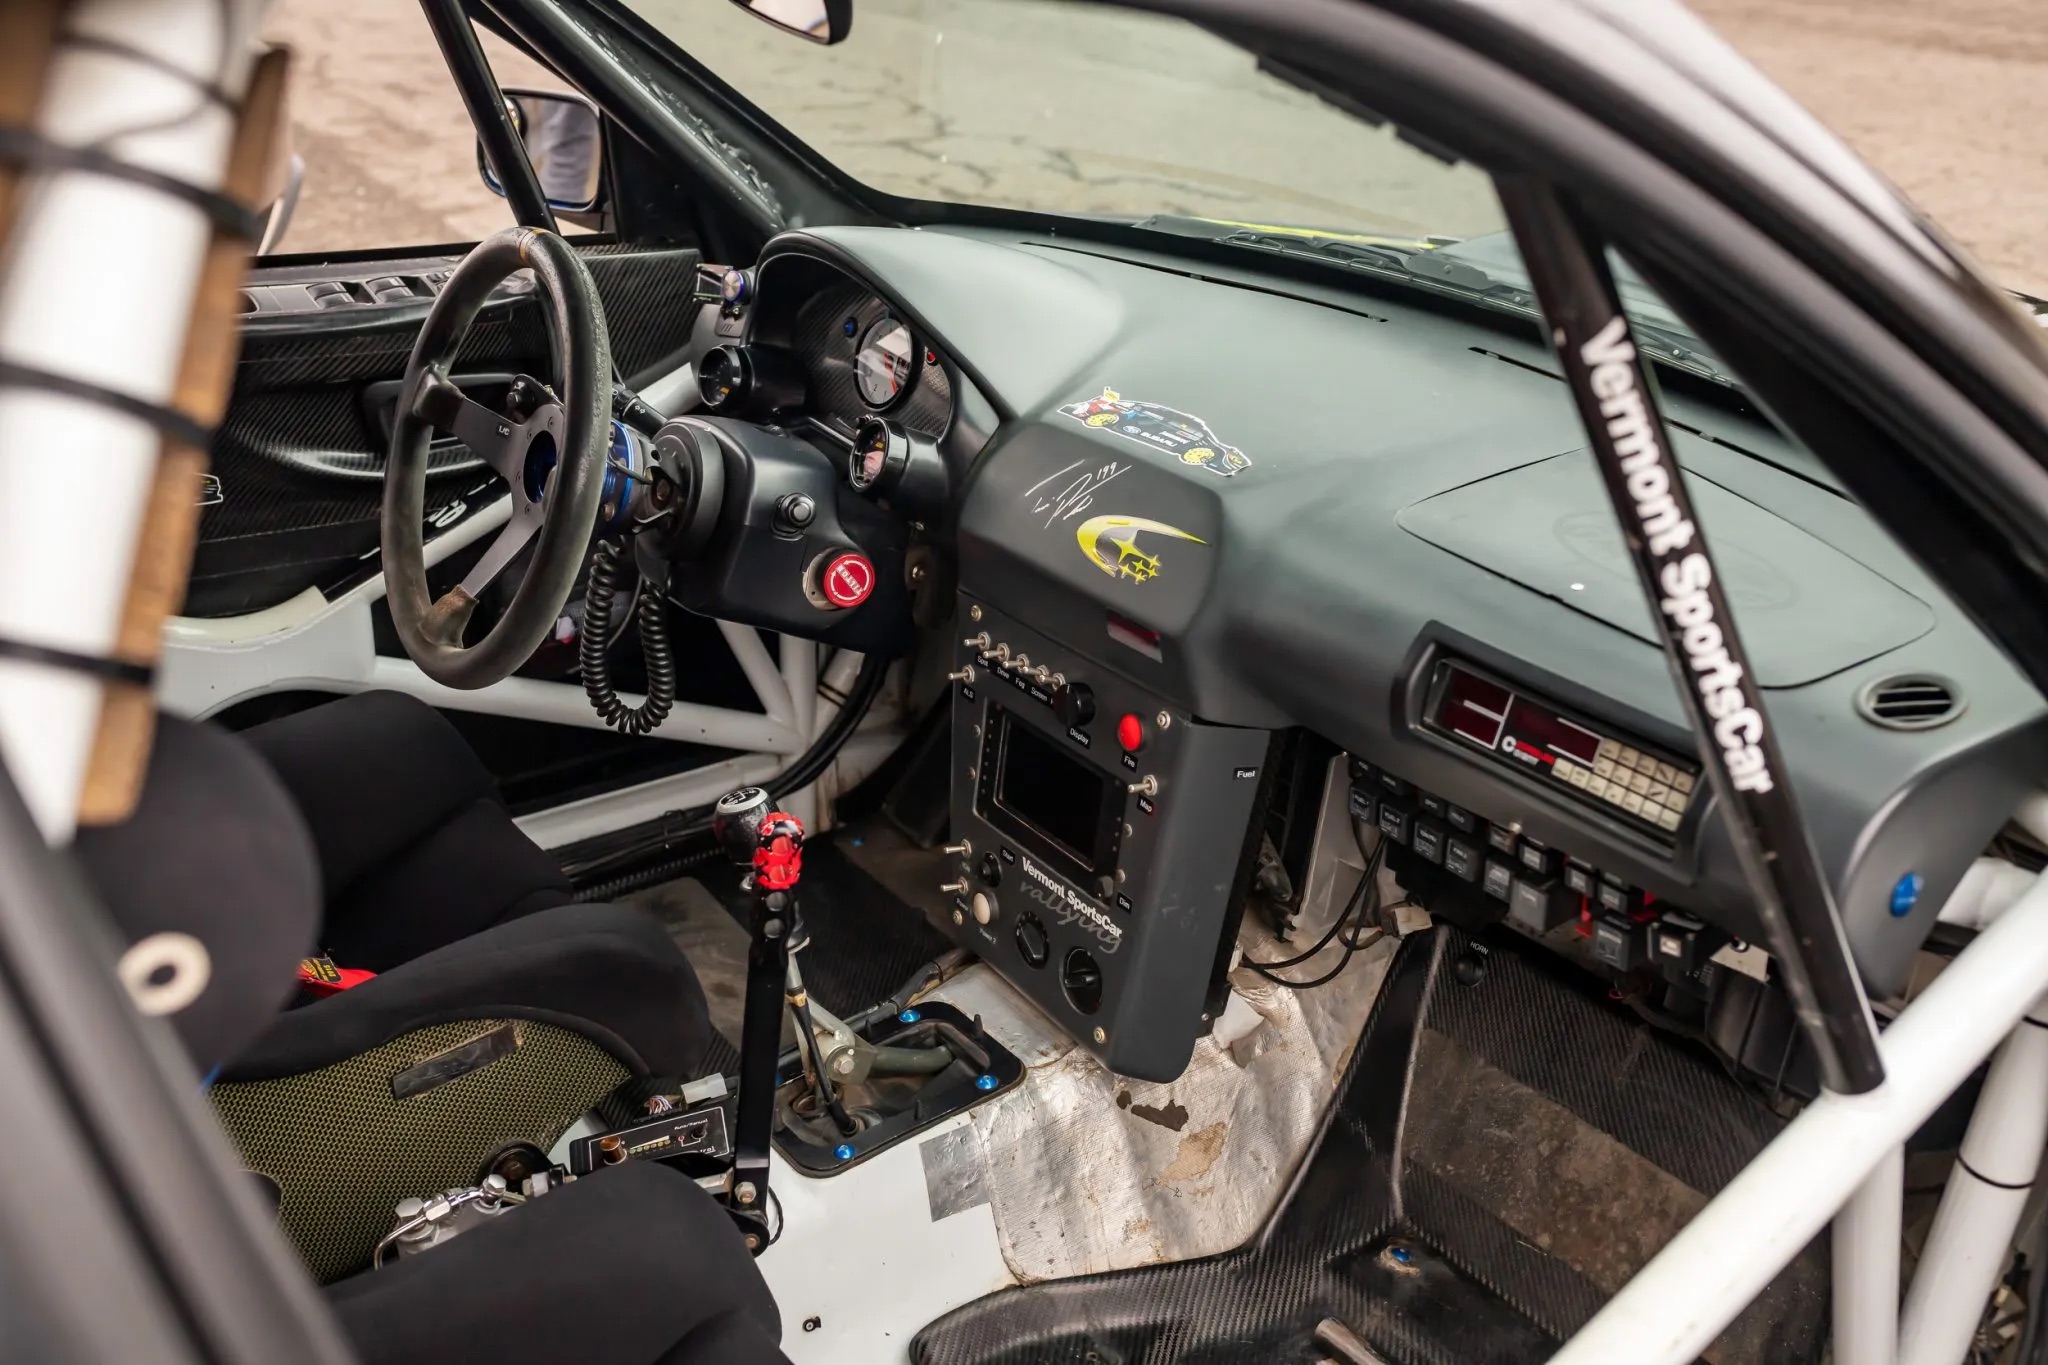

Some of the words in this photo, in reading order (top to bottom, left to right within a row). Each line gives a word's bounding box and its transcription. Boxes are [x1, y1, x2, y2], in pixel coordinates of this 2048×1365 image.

[1096, 461, 1118, 481] 199
[1580, 315, 1697, 557] Vermont
[1660, 551, 1775, 796] SportsCar
[1015, 678, 1026, 690] Fog
[1069, 727, 1089, 745] Display
[1236, 770, 1256, 779] Fuel
[1022, 856, 1065, 899] Vermont
[1066, 889, 1123, 938] SportsCar
[1470, 941, 1489, 955] HORN
